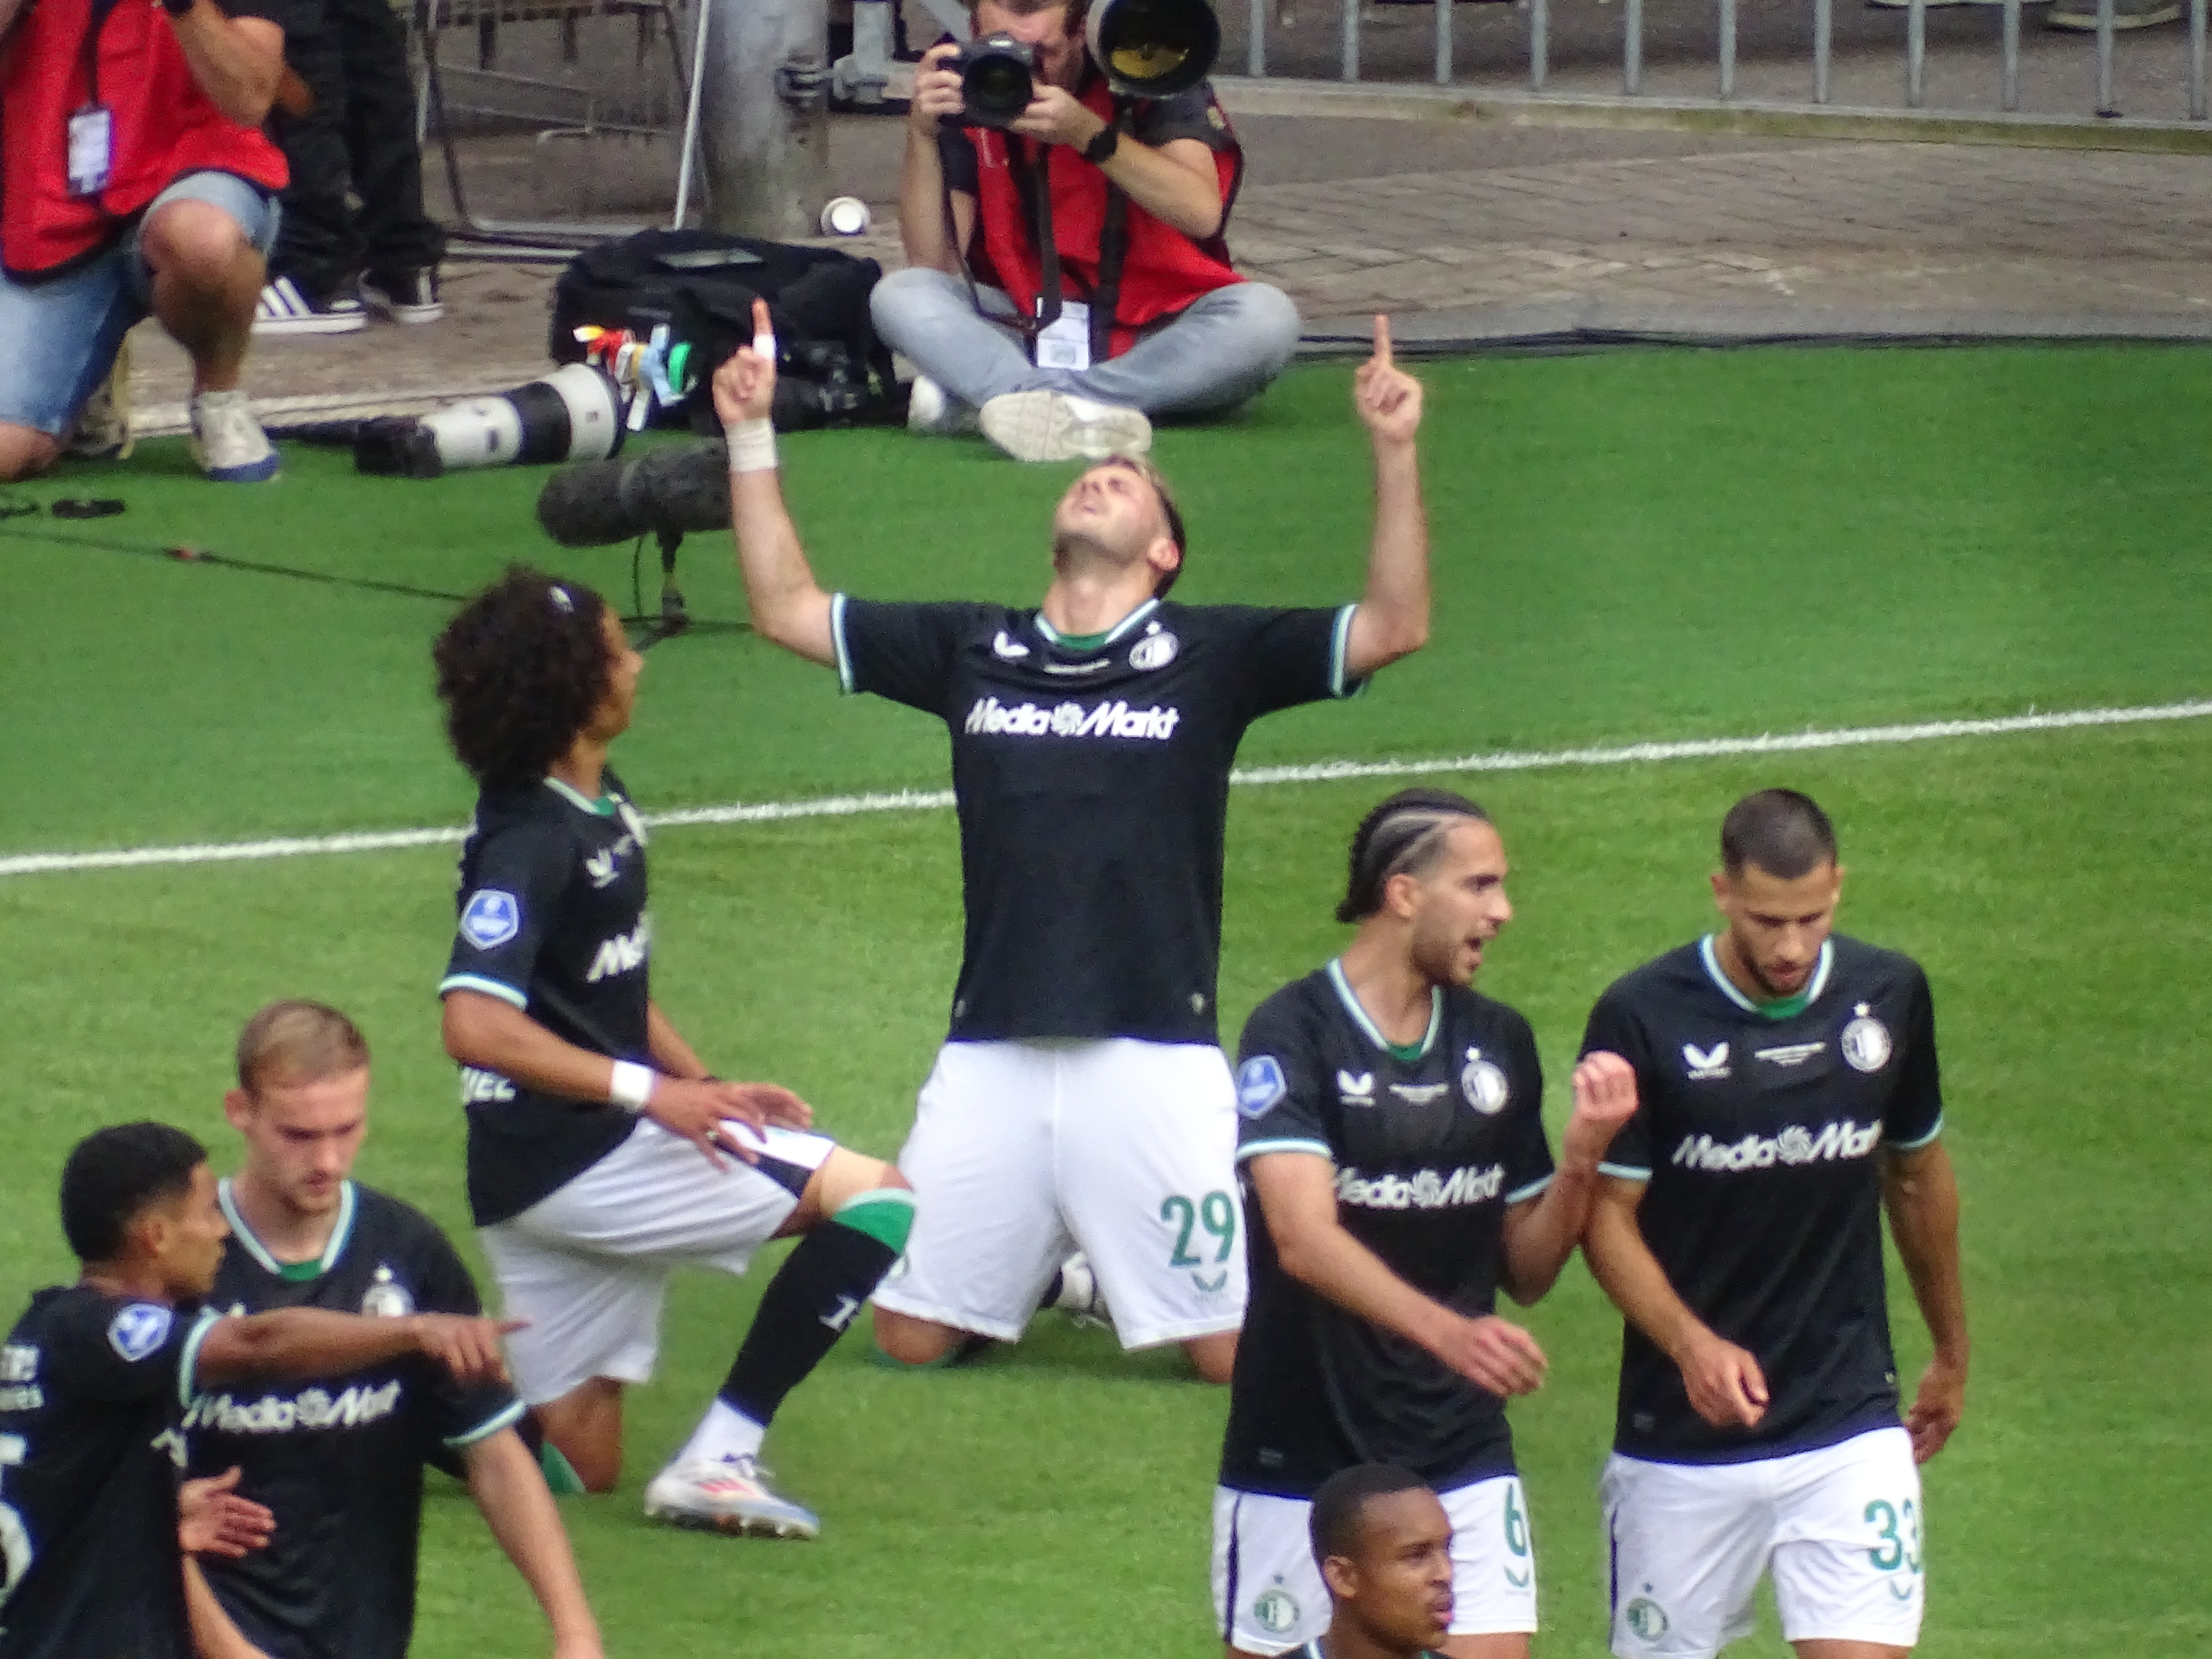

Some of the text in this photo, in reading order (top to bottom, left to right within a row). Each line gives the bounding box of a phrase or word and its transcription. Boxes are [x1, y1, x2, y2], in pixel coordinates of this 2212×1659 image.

[1160, 1192, 1234, 1266] 29
[1505, 1483, 1528, 1556] 6
[1864, 1499, 1922, 1575] 33
